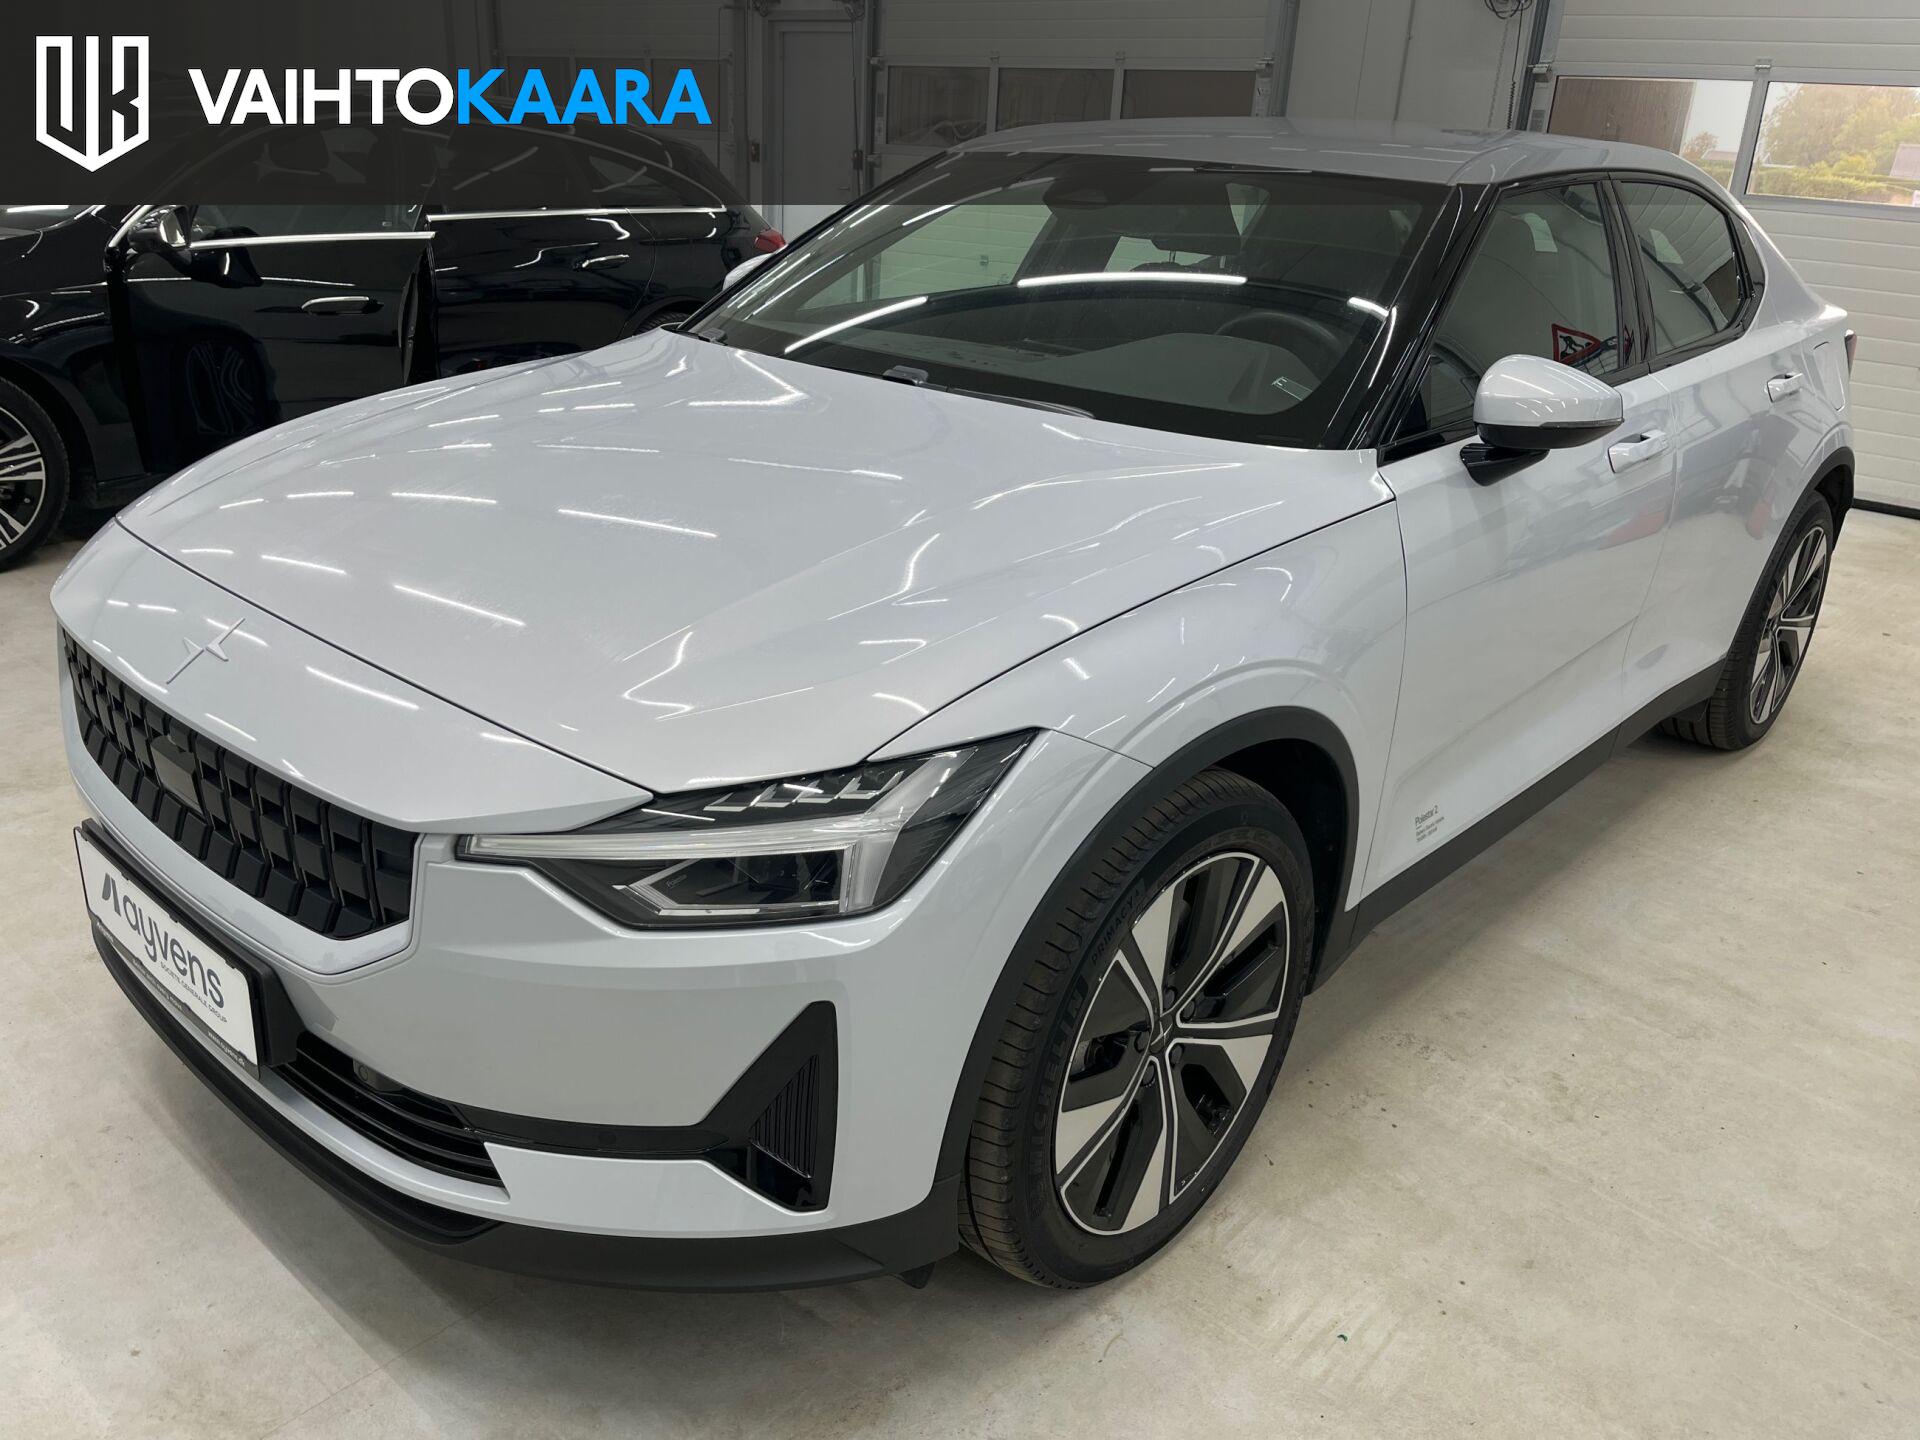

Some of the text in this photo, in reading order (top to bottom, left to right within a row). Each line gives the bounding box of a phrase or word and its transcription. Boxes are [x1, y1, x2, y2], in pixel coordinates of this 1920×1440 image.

[122, 894, 225, 1009] ayvens
[1091, 895, 1133, 966] PRIMACY
[1029, 982, 1087, 1176] MICHELIN
